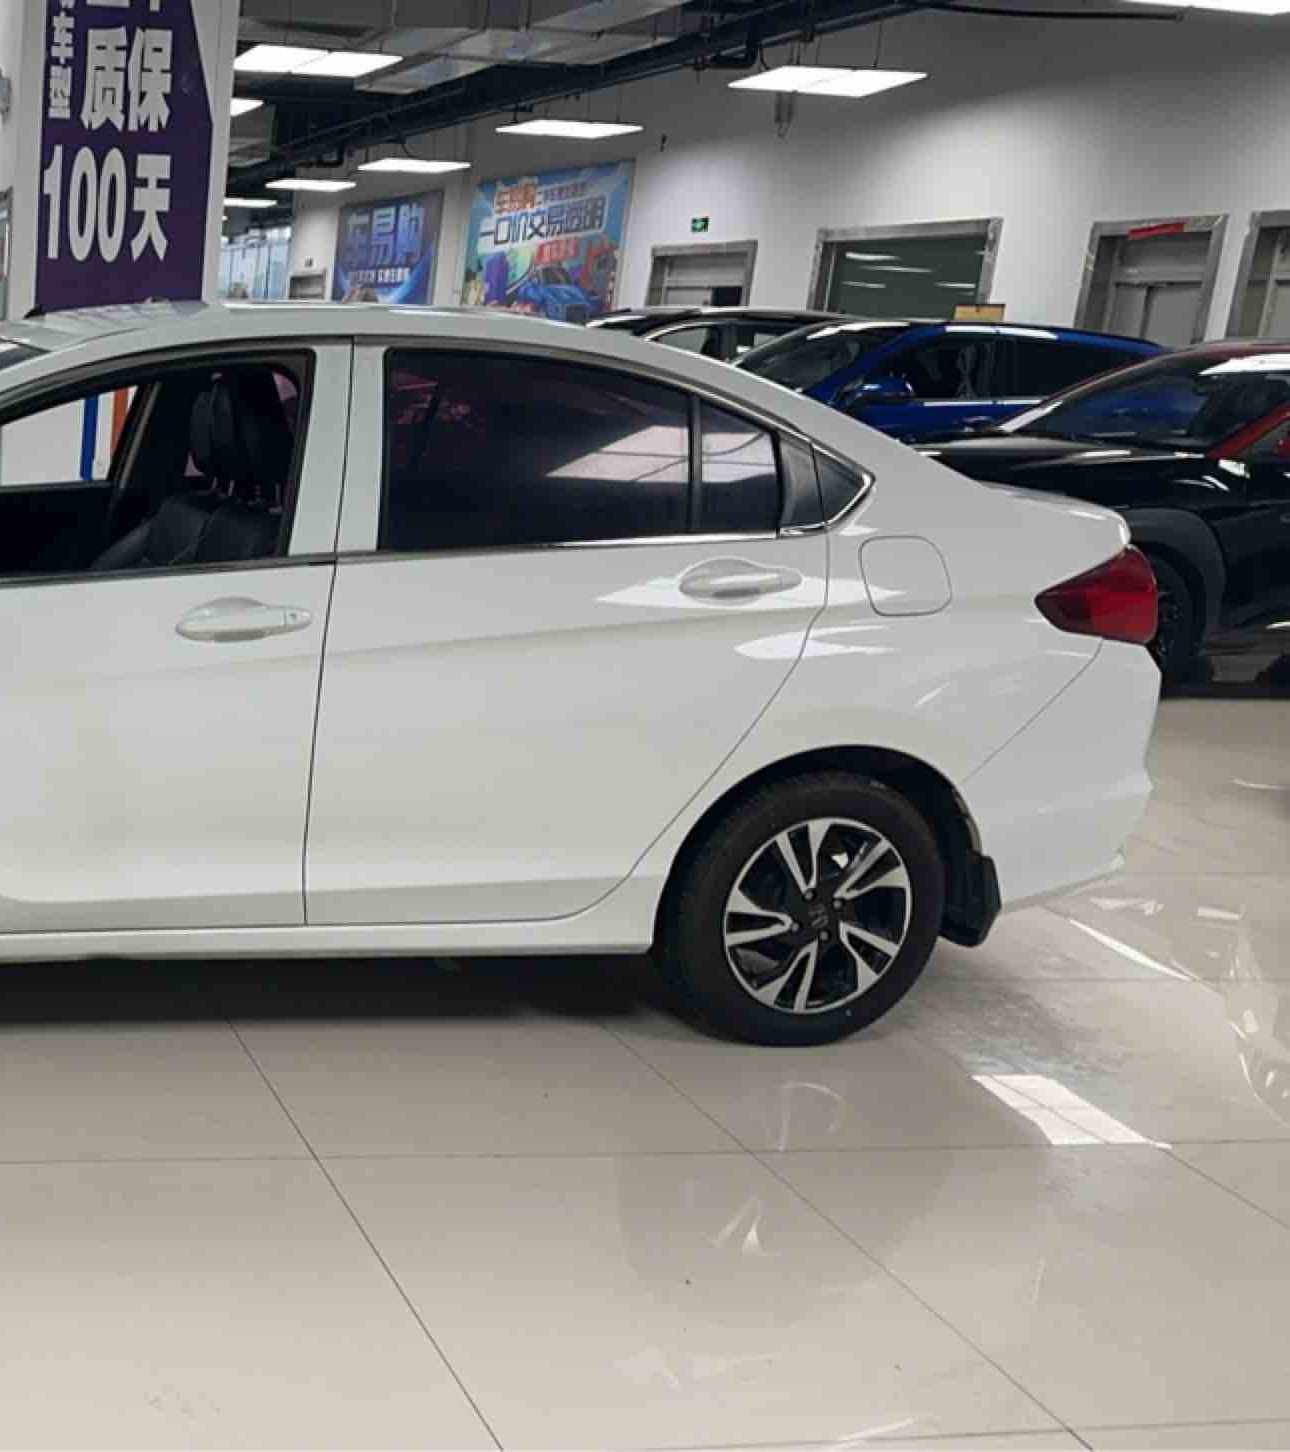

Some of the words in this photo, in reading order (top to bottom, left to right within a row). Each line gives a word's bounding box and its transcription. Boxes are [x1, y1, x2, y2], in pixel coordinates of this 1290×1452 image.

[48, 0, 75, 119] 车型
[80, 26, 173, 132] 质保
[43, 145, 172, 263] 100天
